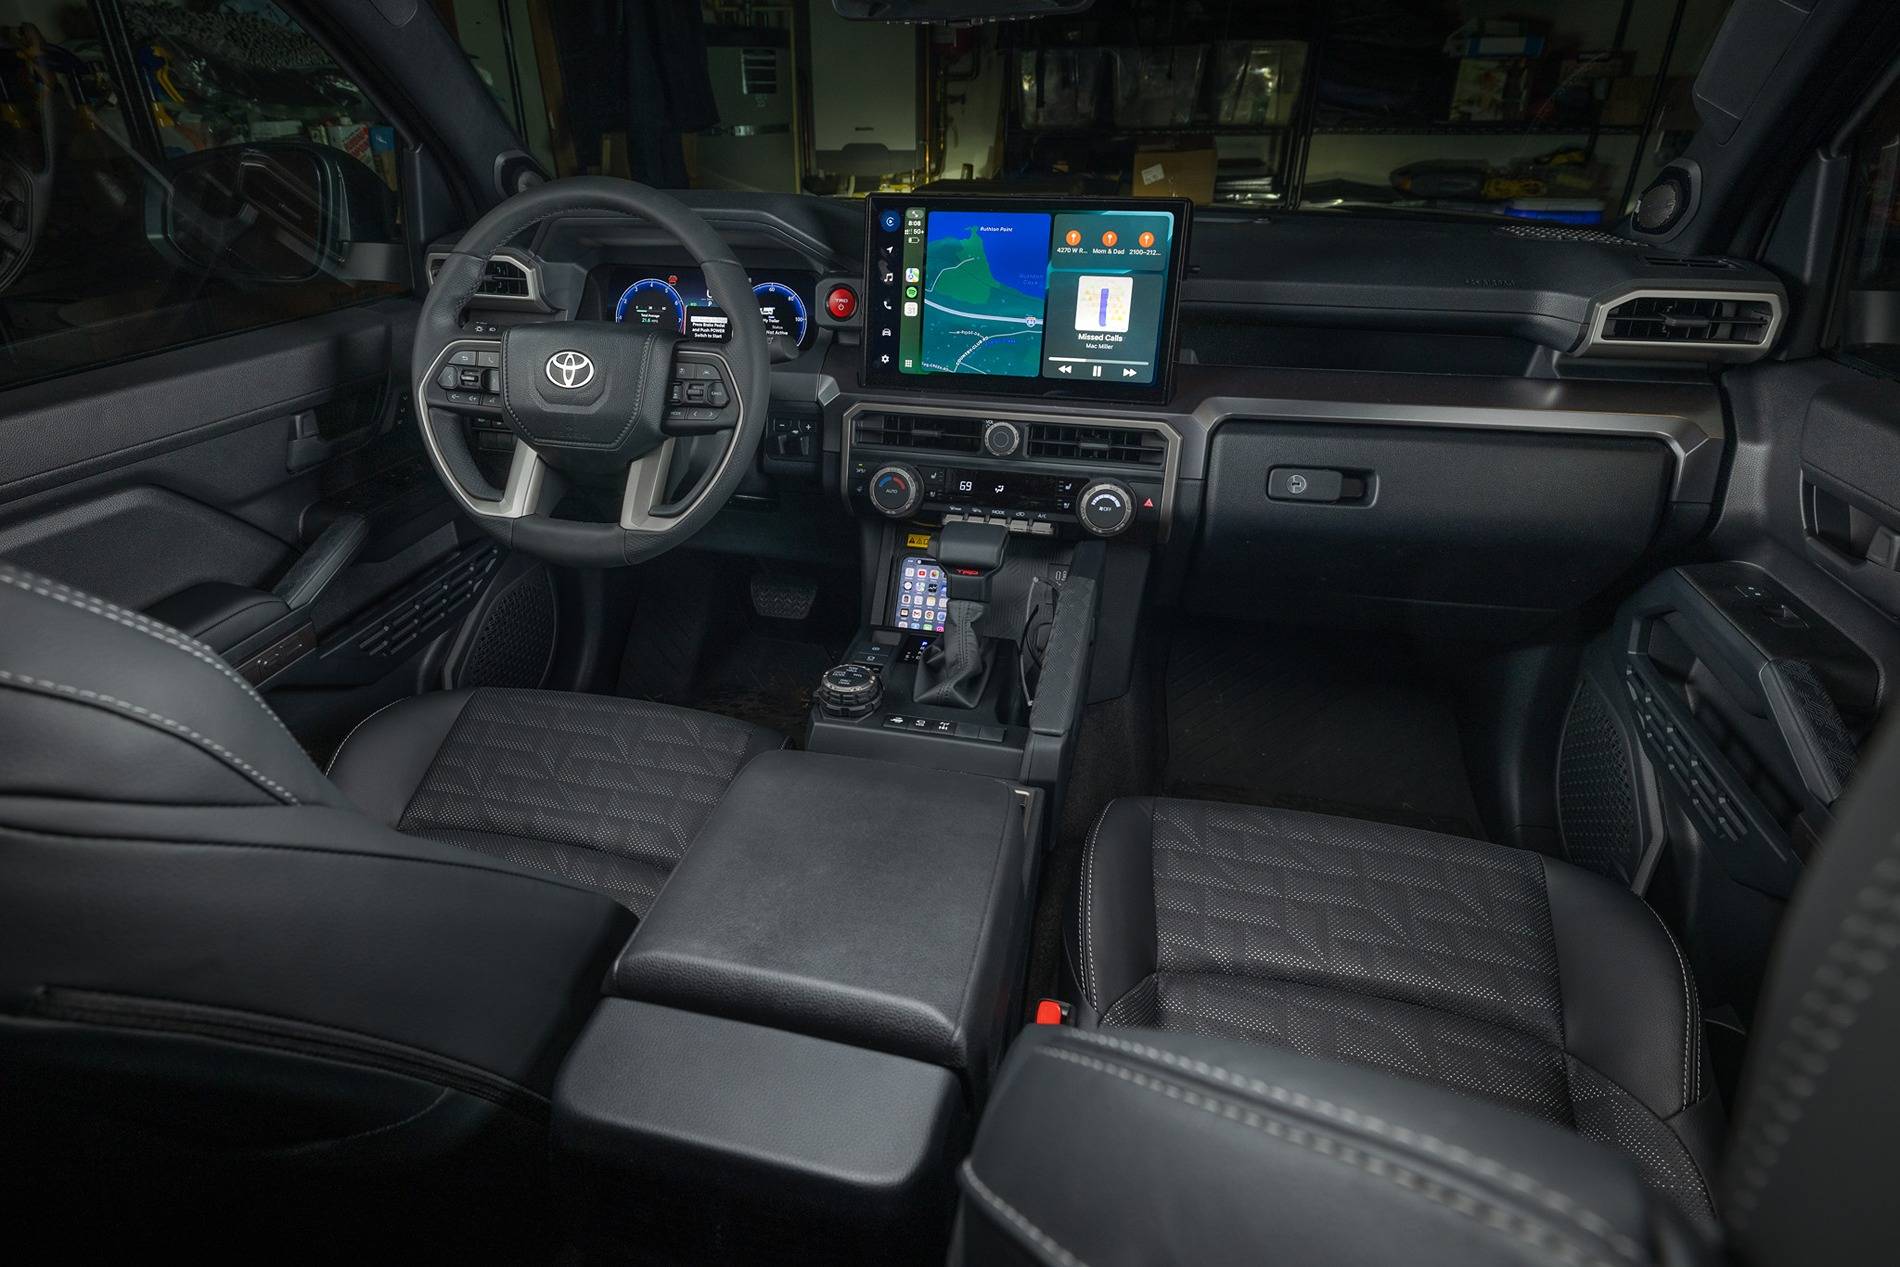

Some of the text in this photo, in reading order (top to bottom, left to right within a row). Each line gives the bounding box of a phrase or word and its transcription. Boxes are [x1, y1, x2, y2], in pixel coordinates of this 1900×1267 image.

[1078, 333, 1123, 342] Missed Calls
[959, 480, 973, 491] 69
